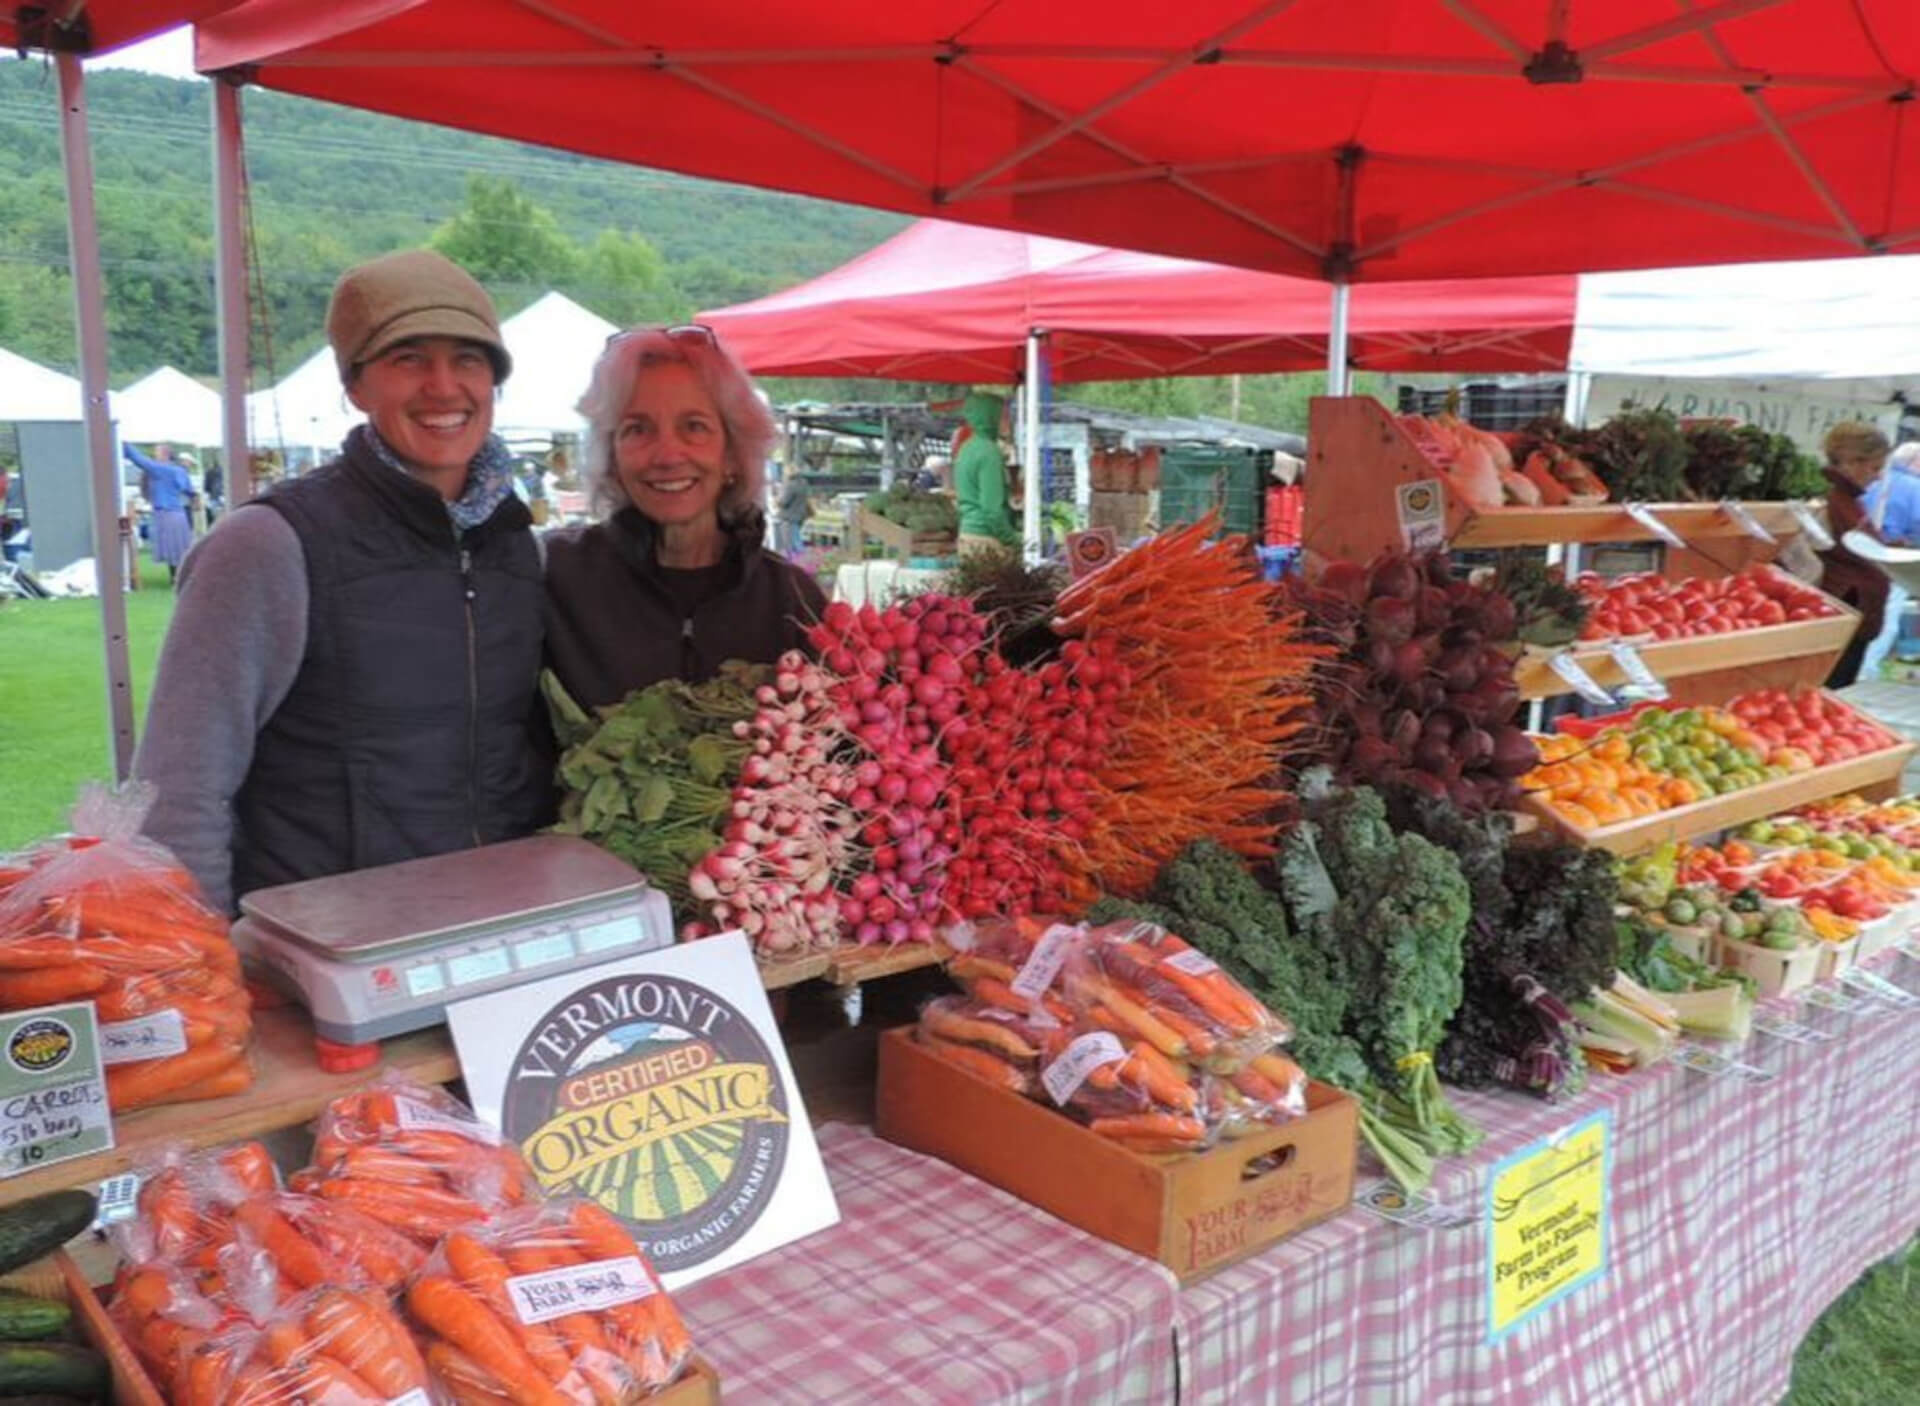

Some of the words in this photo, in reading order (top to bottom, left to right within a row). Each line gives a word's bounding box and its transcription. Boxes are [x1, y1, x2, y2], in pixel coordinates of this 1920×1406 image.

[517, 982, 731, 1081] VERMONT
[567, 1044, 708, 1105] CERTIFIED
[531, 1068, 763, 1176] ORGANIC
[652, 1210, 734, 1257] ORGANIC
[728, 1136, 775, 1217] FARMERS
[1518, 1200, 1579, 1244] Vermont
[1495, 1249, 1534, 1284] Farm
[1536, 1239, 1552, 1257] to
[1517, 1245, 1579, 1291] Program
